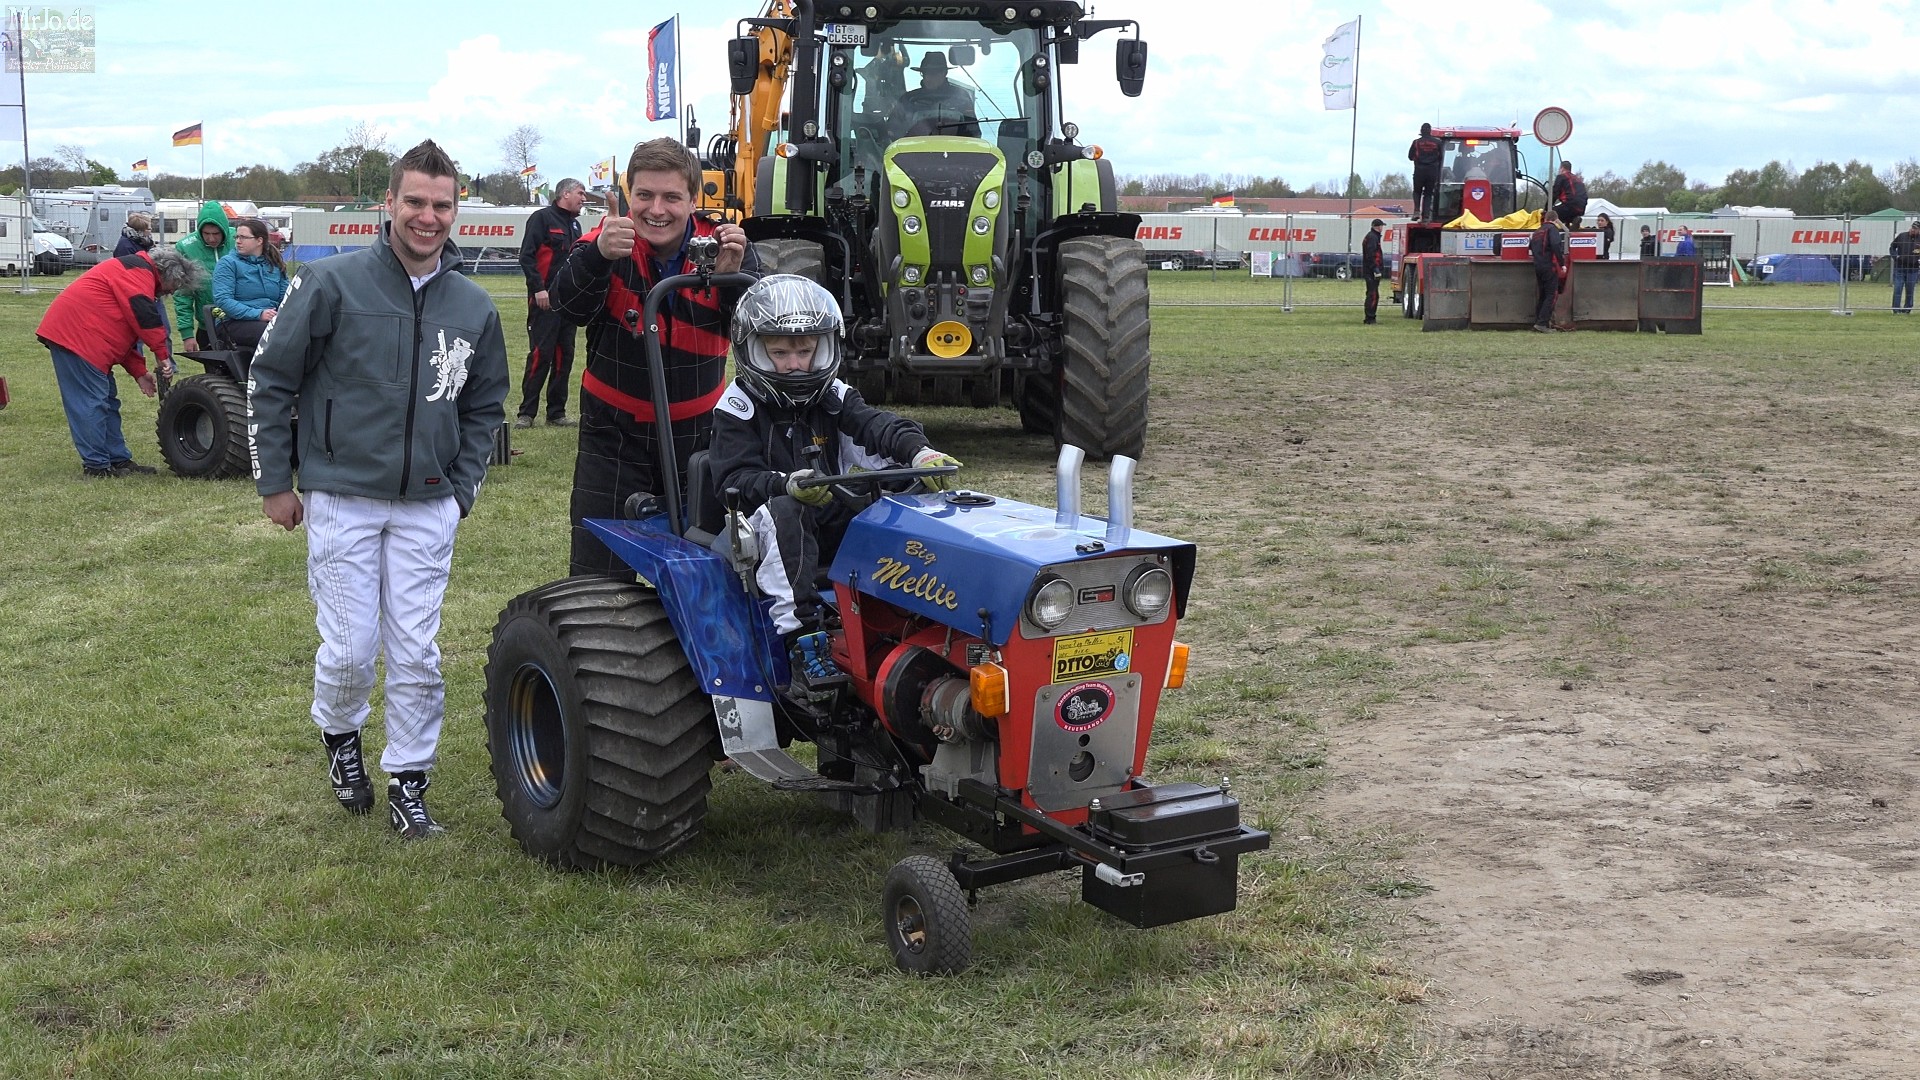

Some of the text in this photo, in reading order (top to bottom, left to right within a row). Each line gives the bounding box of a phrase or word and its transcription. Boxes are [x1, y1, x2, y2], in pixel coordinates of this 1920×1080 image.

[835, 25, 847, 34] GT
[459, 226, 514, 236] CLAAS
[1136, 227, 1182, 240] AAS
[1248, 228, 1317, 242] CLAAS
[1792, 231, 1861, 244] CLAAS
[906, 540, 936, 565] Big
[872, 557, 958, 610] Mellie
[1058, 655, 1094, 674] DTTO
[1064, 718, 1104, 732] NEUENLANDE
[336, 790, 354, 798] OMP
